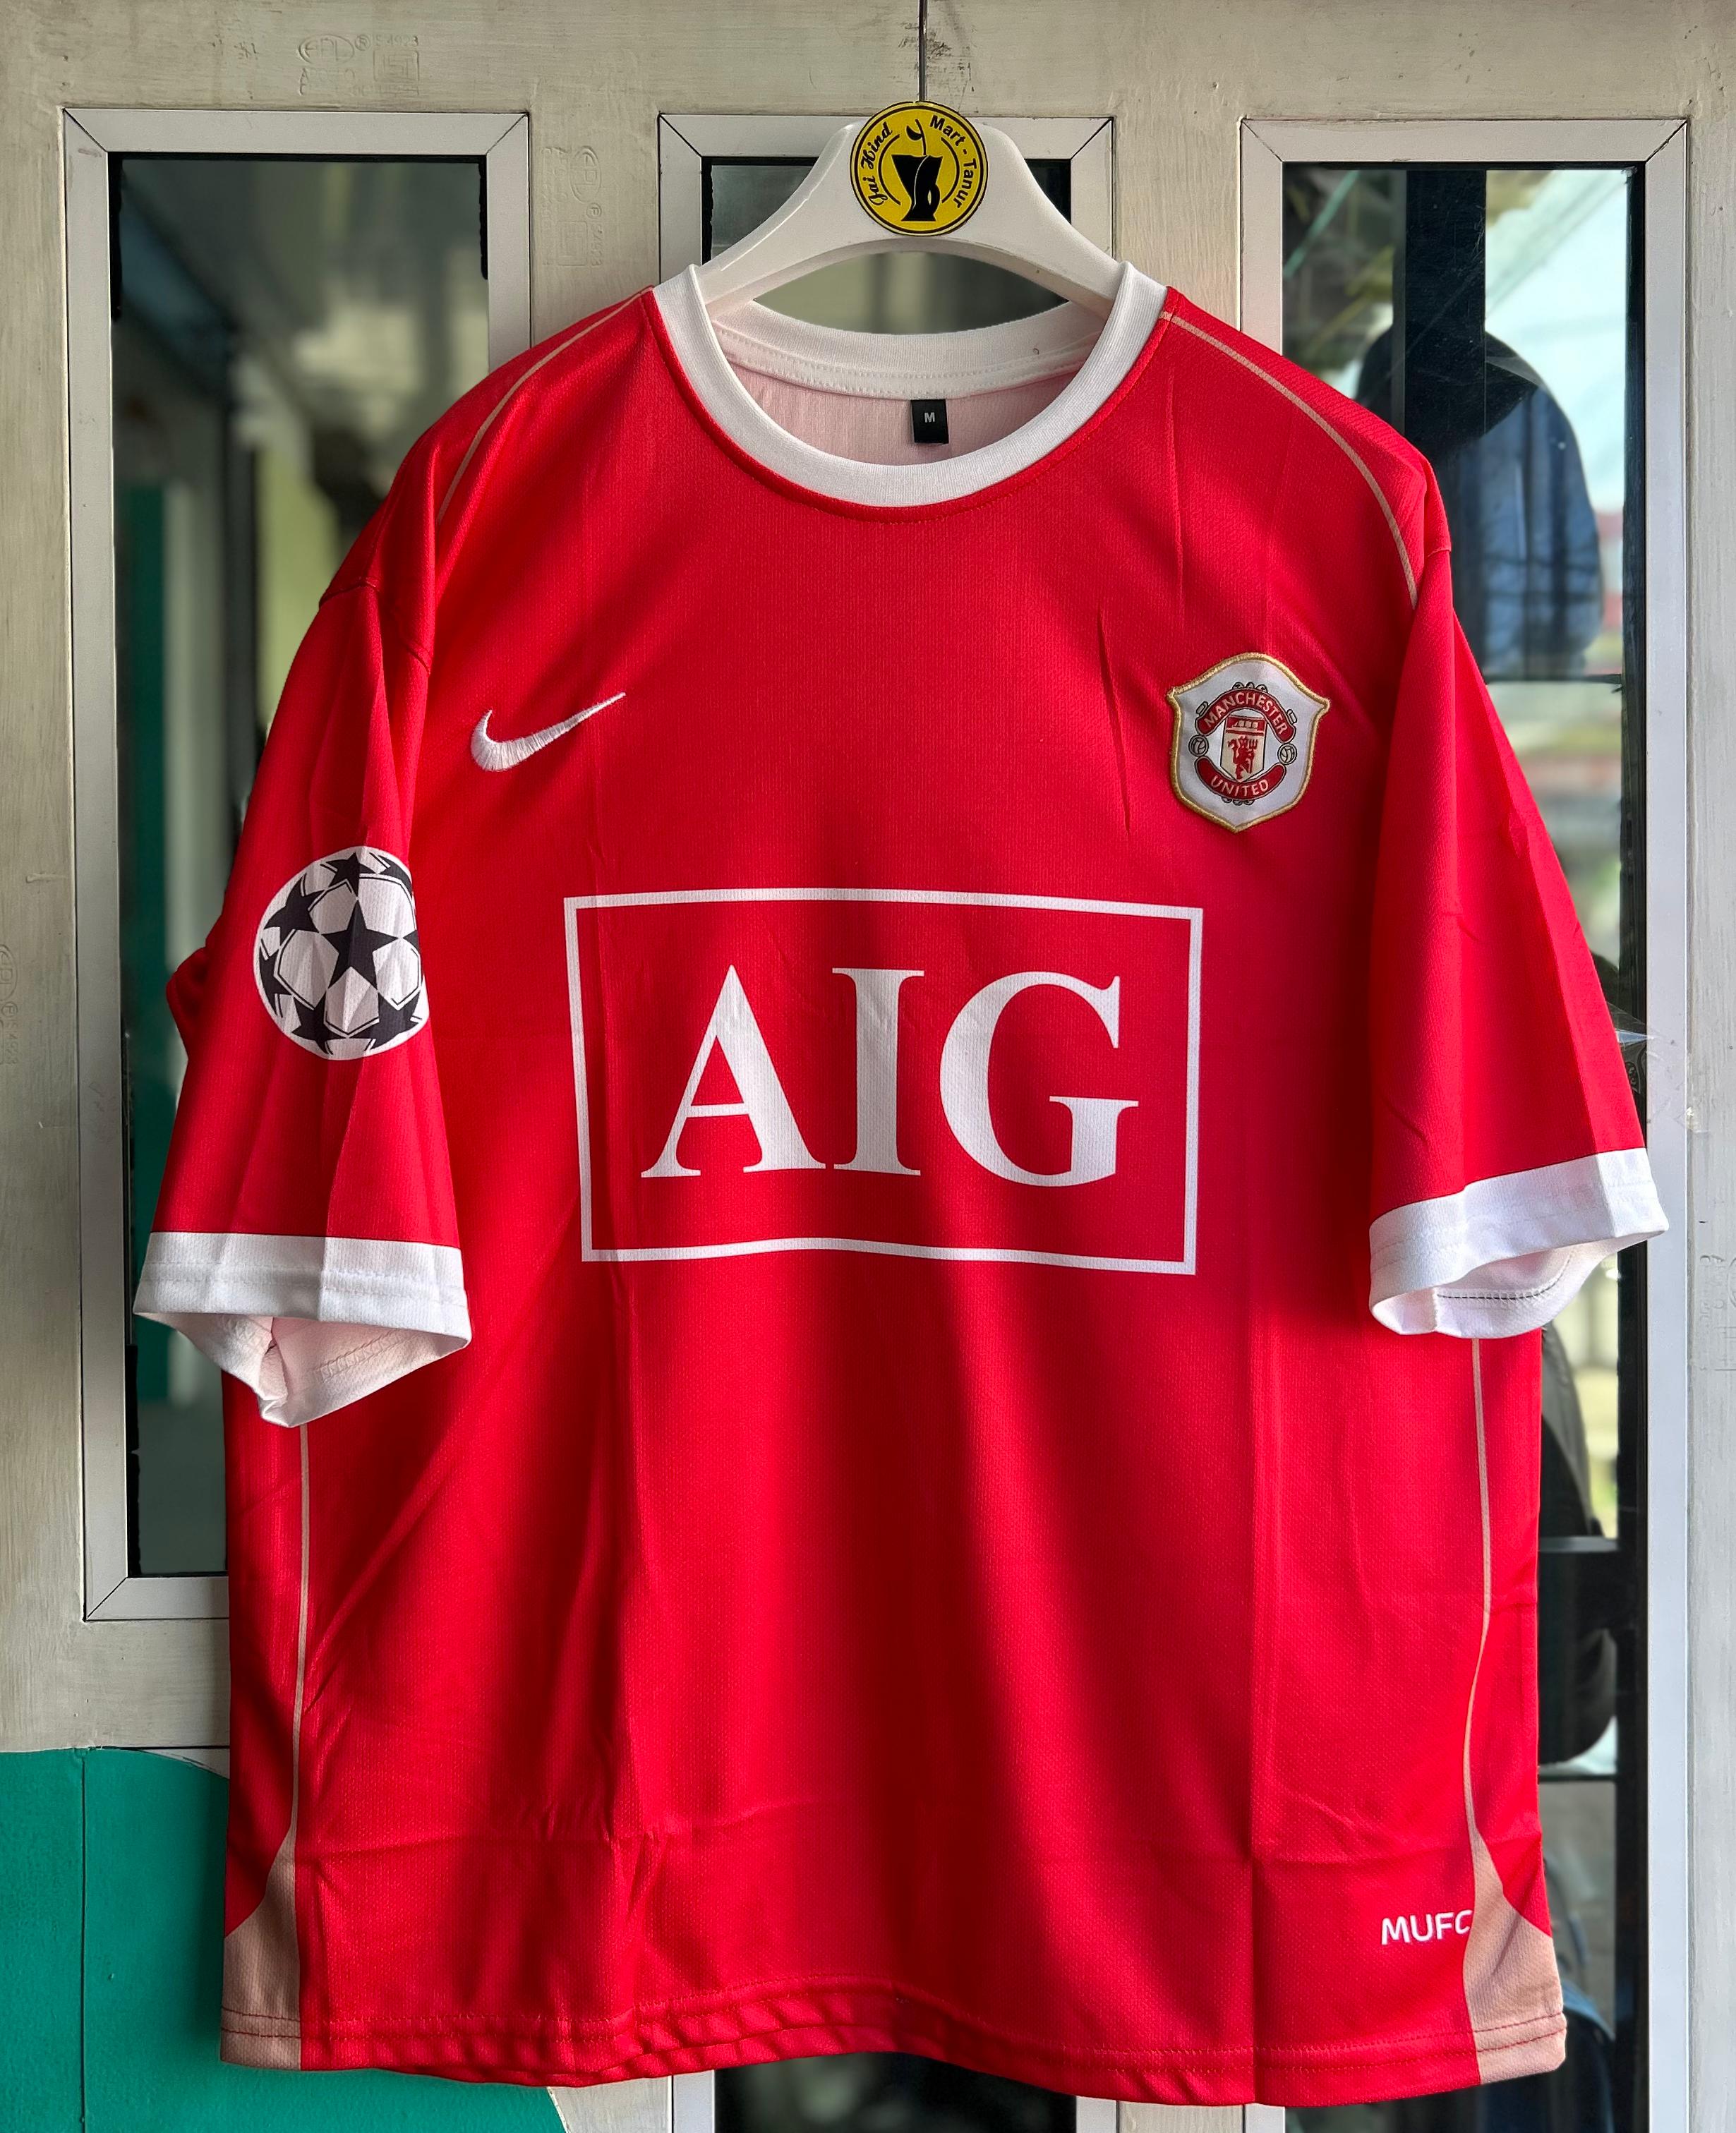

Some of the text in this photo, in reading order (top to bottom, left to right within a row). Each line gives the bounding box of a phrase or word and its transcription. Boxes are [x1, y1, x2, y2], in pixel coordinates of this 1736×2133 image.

[860, 121, 893, 169] Hind
[929, 114, 966, 147] Mart
[953, 158, 977, 208] Tanur
[924, 411, 935, 423] M
[1204, 692, 1289, 735] MANCHESTER
[1210, 775, 1269, 797] UNITED
[640, 965, 1139, 1188] AIG
[1381, 1909, 1473, 1945] MUFC
